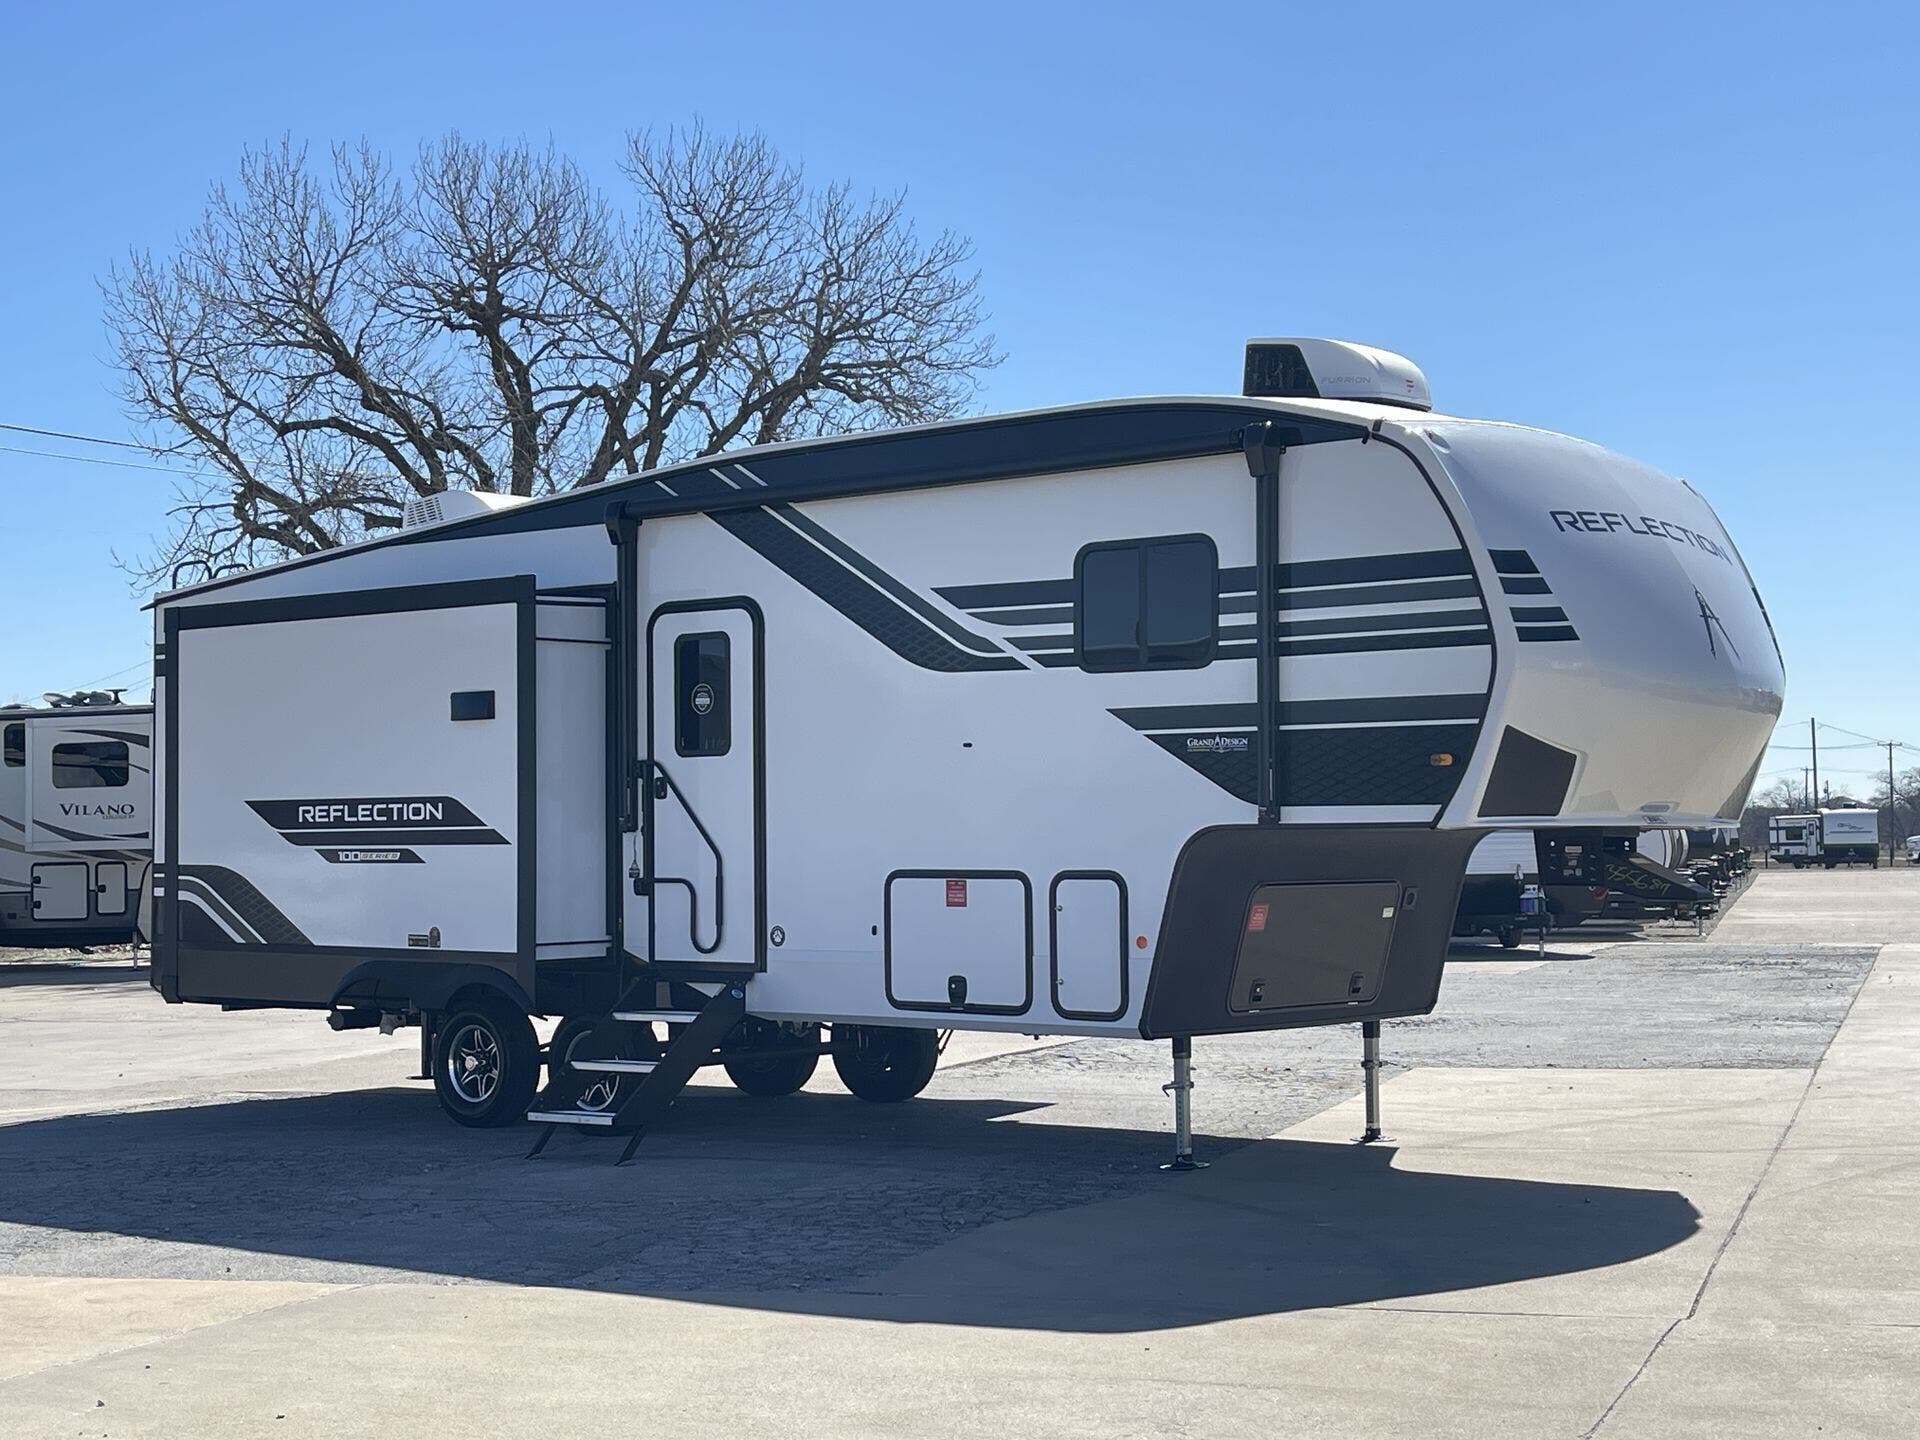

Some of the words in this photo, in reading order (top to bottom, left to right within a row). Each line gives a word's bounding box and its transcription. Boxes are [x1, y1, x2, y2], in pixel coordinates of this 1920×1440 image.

[1320, 376, 1372, 385] FURRION
[1549, 510, 1733, 566] REFLECTION
[59, 803, 135, 816] VILANO
[298, 802, 444, 823] REFLECTION
[337, 851, 360, 861] 100
[361, 852, 399, 860] SERIES
